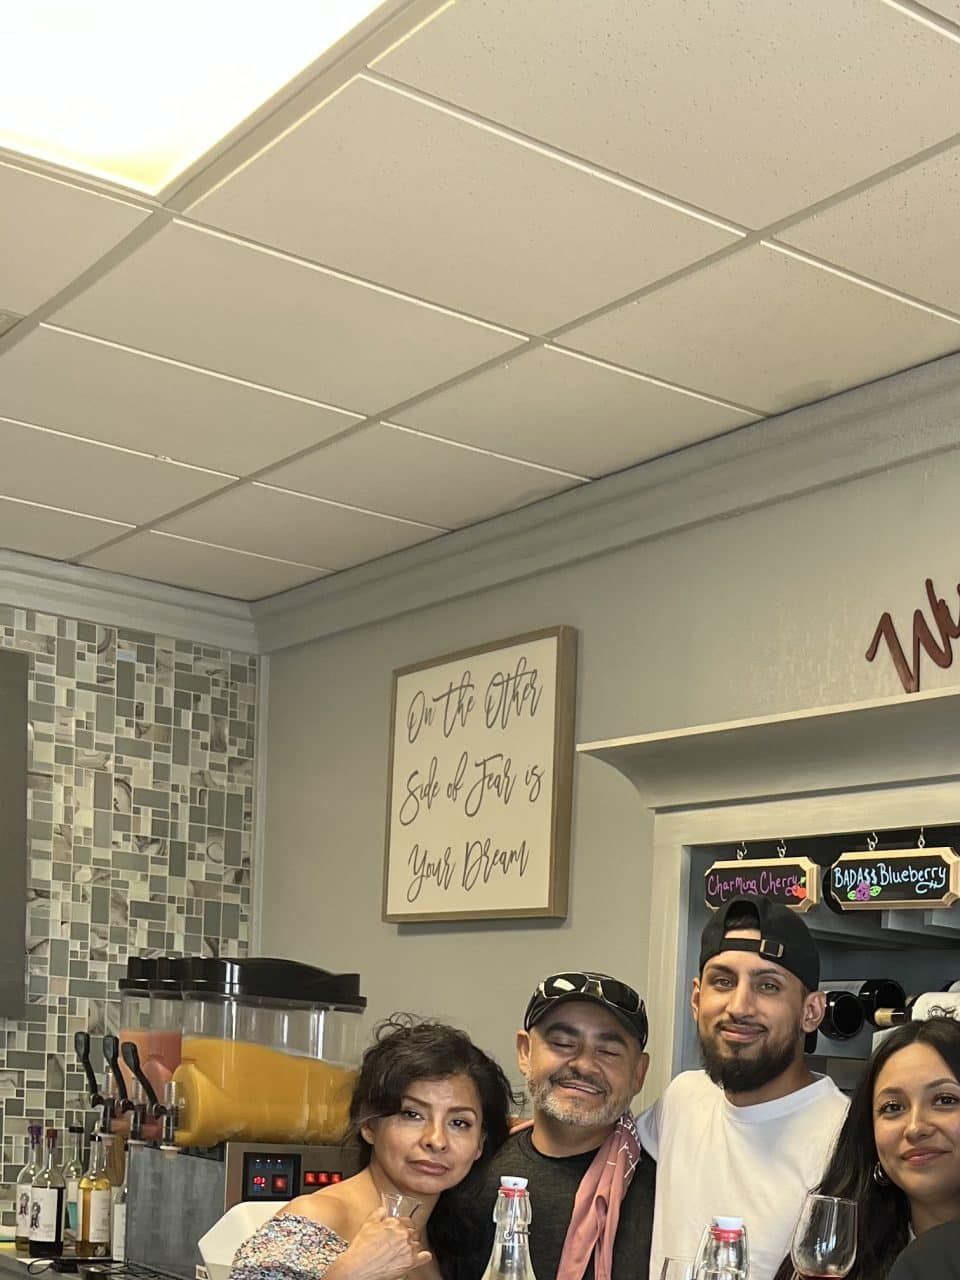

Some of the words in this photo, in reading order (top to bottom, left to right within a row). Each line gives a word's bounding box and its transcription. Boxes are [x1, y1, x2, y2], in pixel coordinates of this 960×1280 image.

[407, 690, 436, 744] On
[485, 656, 543, 730] Other
[399, 756, 440, 826] Side
[446, 751, 468, 802] of
[464, 753, 516, 818] Fear
[524, 764, 545, 802] is
[407, 844, 456, 903] Your
[461, 838, 529, 892] Dream
[760, 871, 798, 896] Cherry
[877, 863, 946, 894] Blueberry
